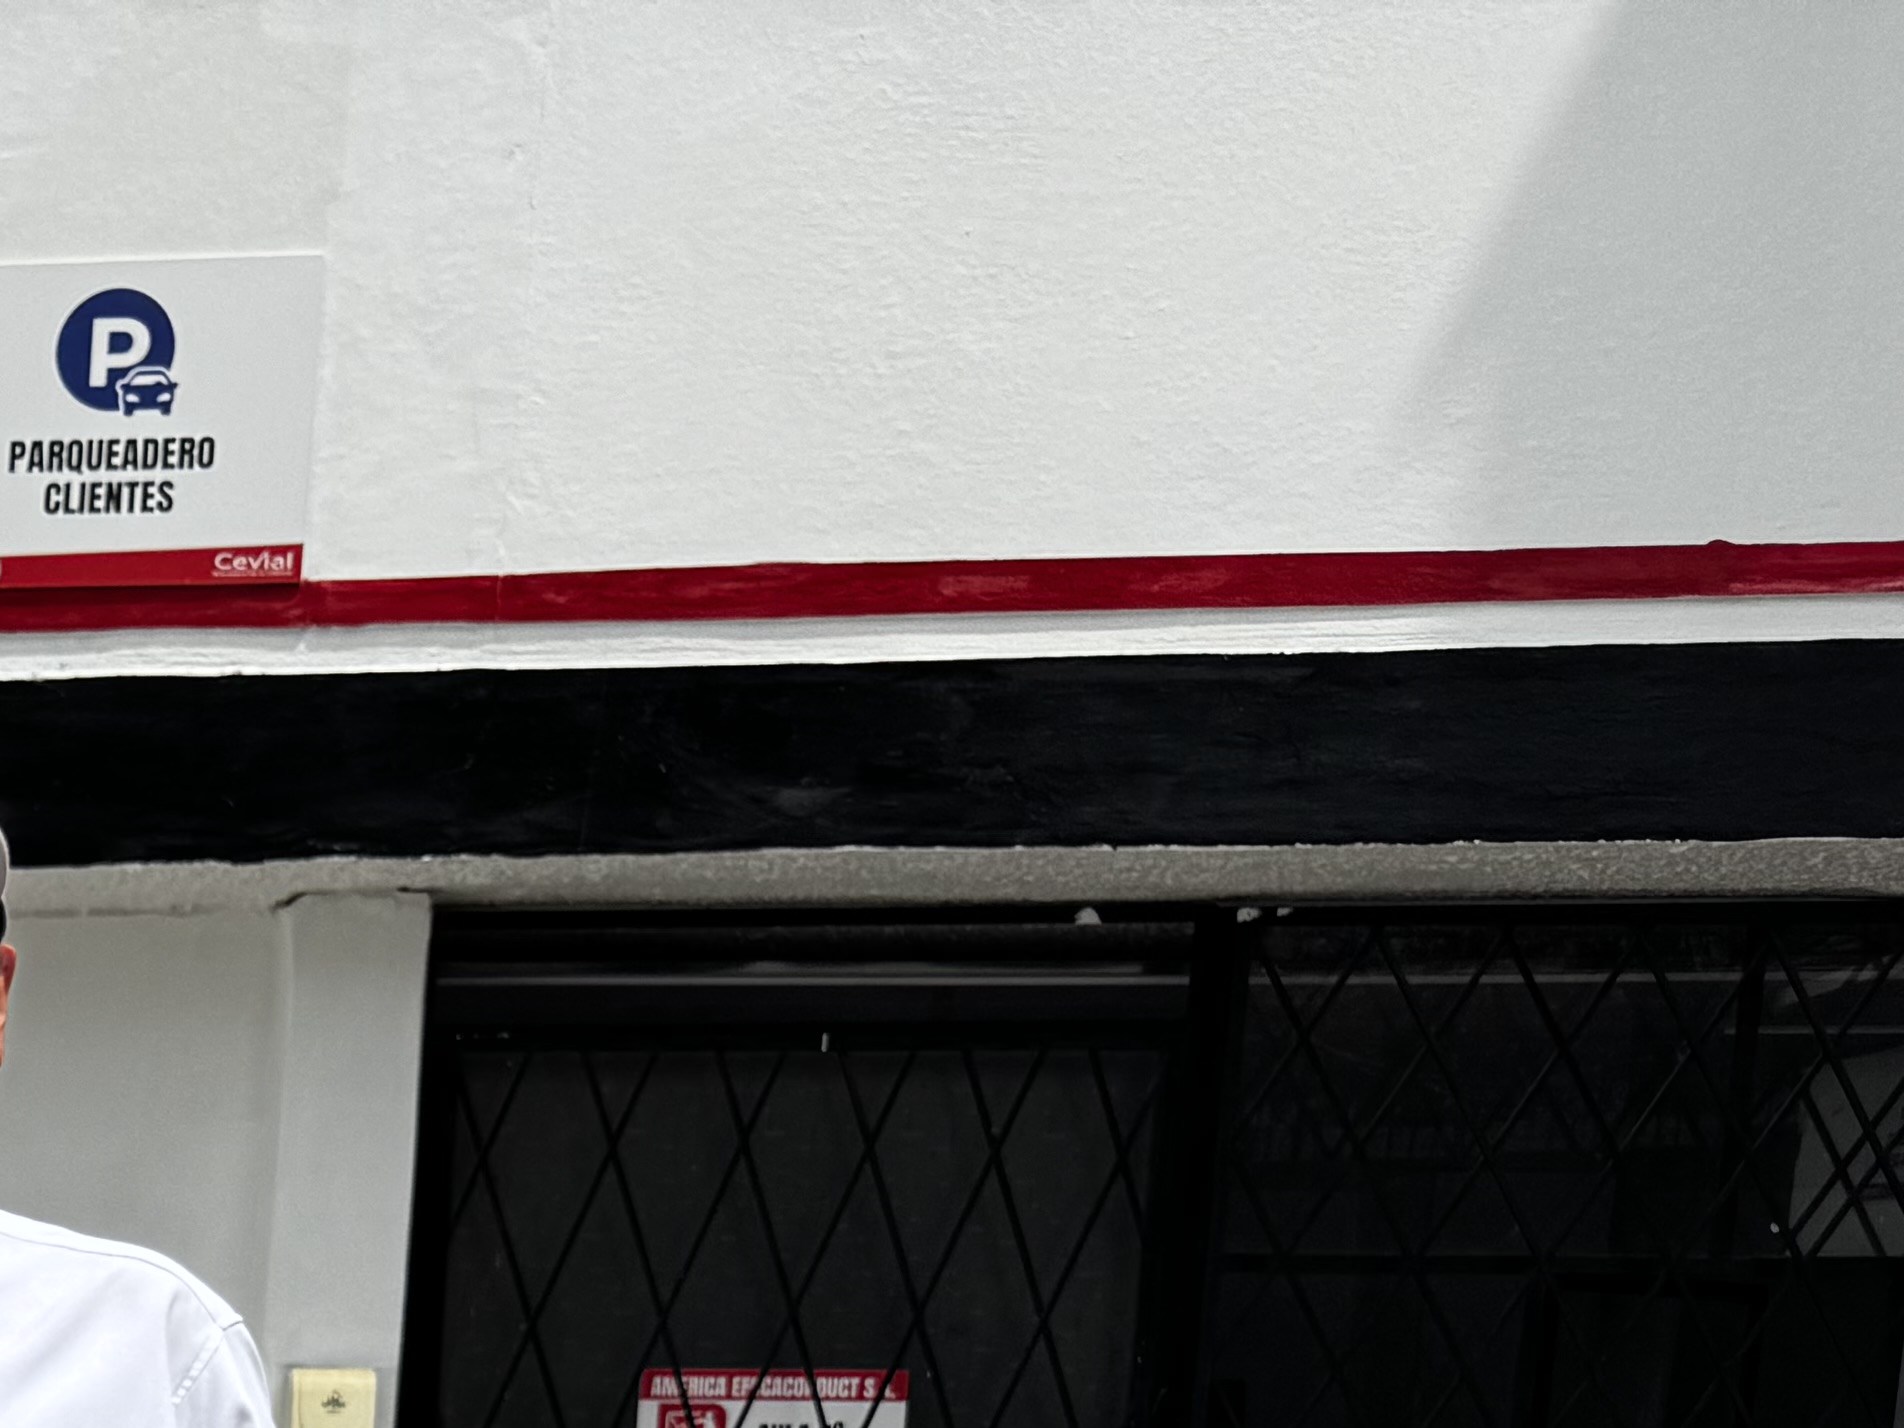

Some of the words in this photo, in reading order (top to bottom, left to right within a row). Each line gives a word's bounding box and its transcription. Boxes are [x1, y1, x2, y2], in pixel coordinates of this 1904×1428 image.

[88, 317, 152, 389] P
[8, 435, 216, 474] PARQUEADERO
[43, 480, 175, 515] CLIENTES
[213, 550, 295, 571] Cevial
